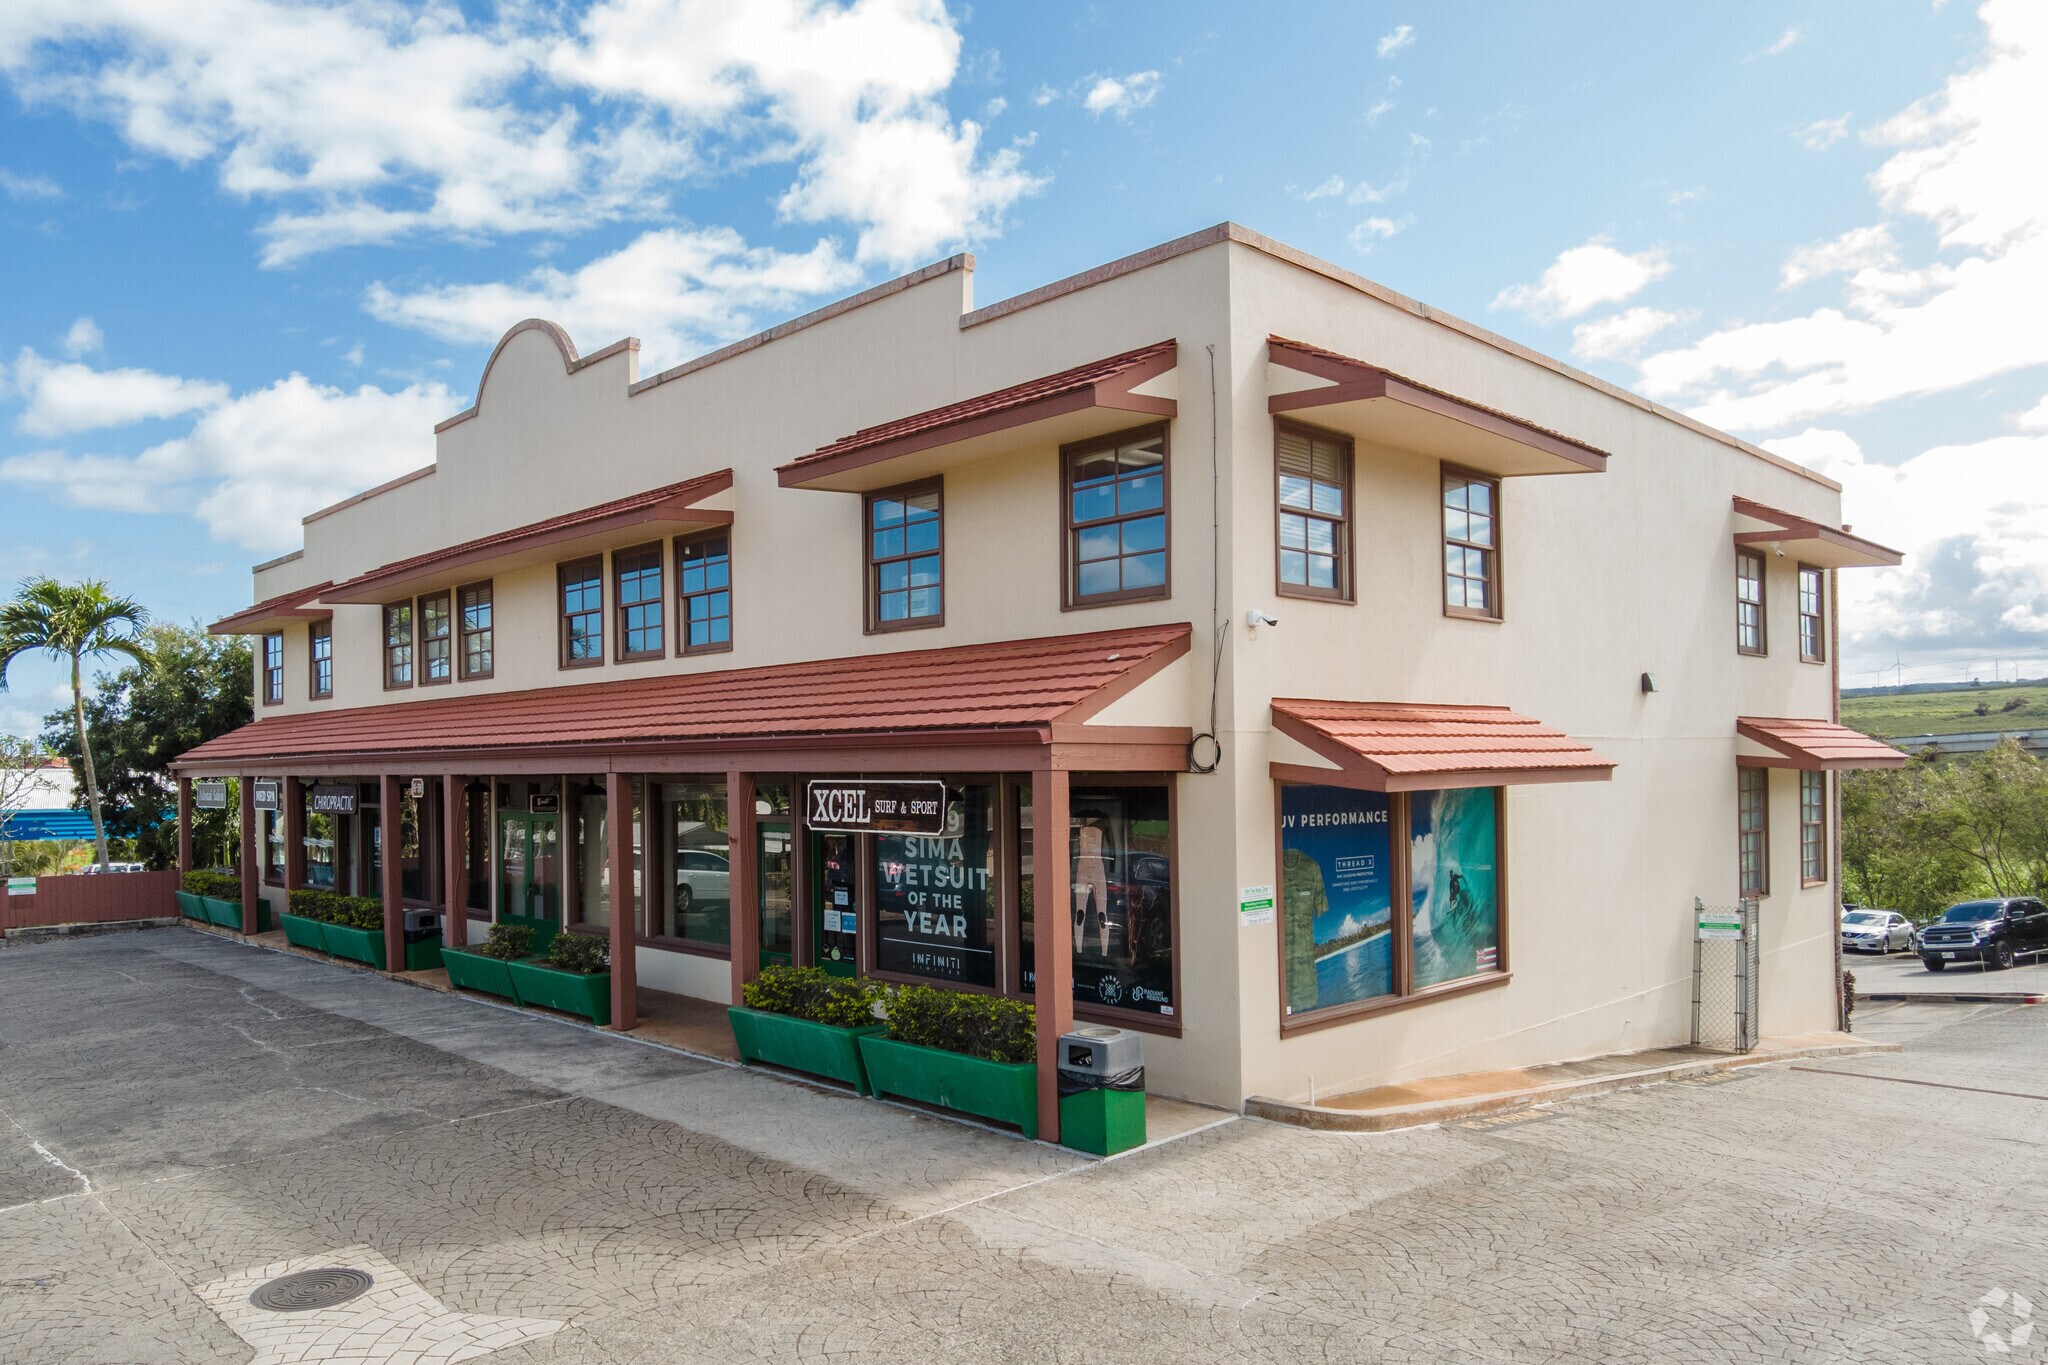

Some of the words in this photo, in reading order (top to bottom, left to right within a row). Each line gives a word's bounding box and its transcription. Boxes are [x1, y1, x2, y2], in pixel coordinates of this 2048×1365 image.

[266, 790, 275, 802] SPA
[314, 795, 354, 811] CHIROPRACTIC
[813, 789, 870, 823] XCEL
[875, 800, 897, 814] SURF
[901, 802, 907, 814] &
[911, 801, 938, 815] SPORT
[1301, 810, 1388, 827] PERFORMANCE
[905, 837, 964, 861] SIMA
[1338, 859, 1365, 868] THREAD
[883, 861, 990, 891] WETSUIT
[908, 892, 927, 905] OF
[932, 893, 962, 909] THE
[904, 910, 968, 938] YEAR
[912, 953, 960, 970] INFINITI
